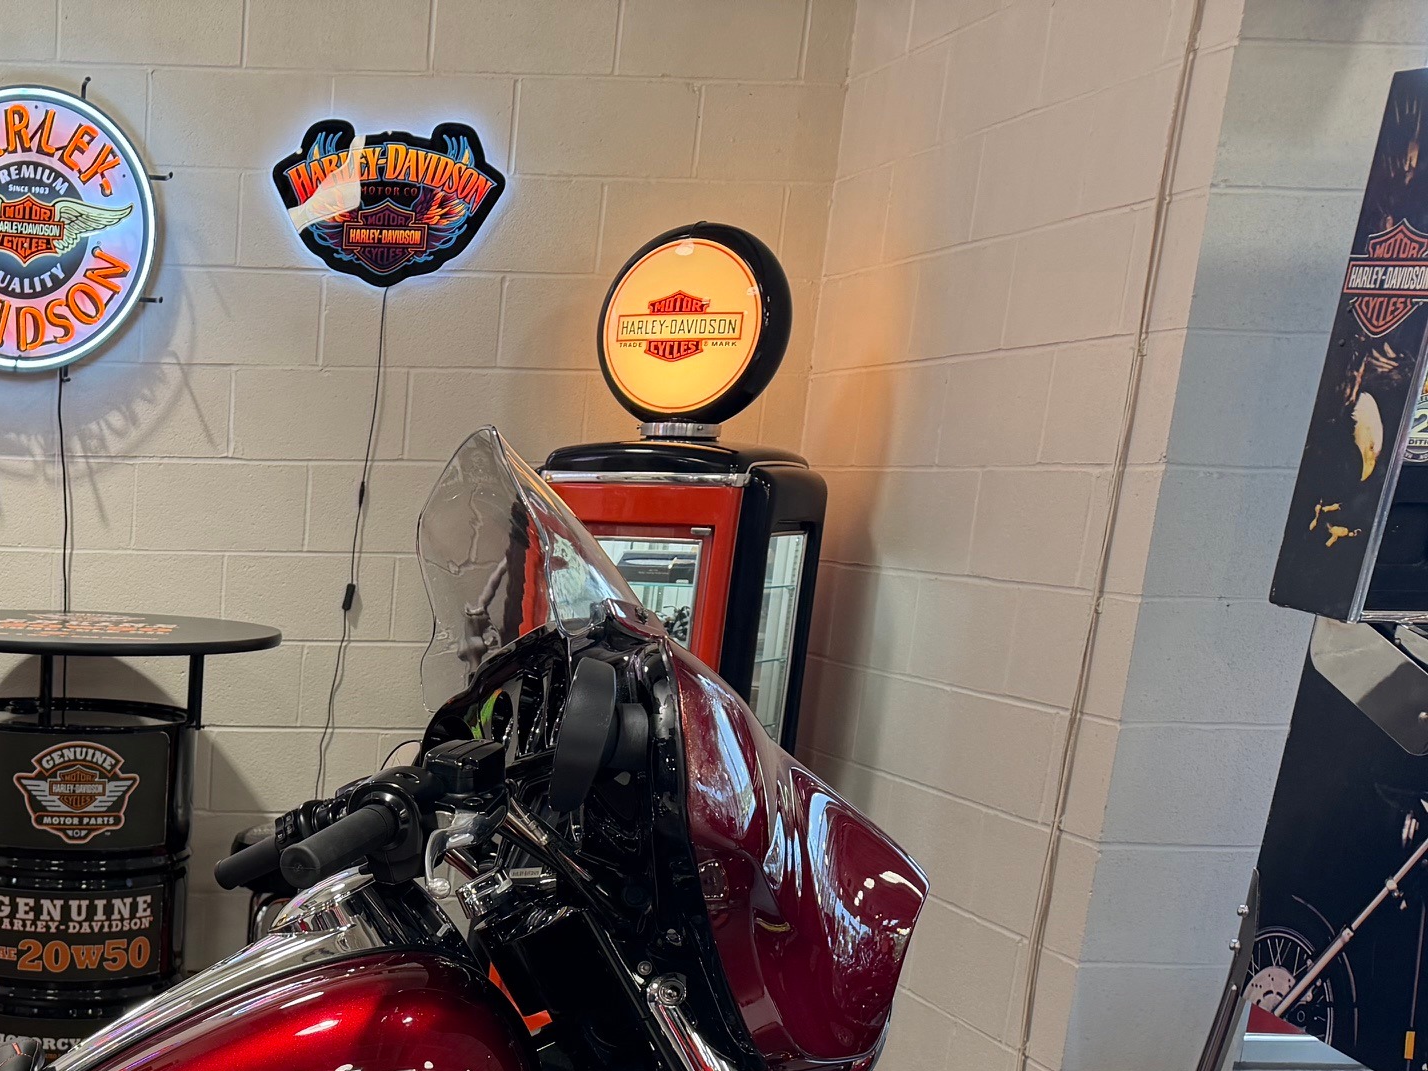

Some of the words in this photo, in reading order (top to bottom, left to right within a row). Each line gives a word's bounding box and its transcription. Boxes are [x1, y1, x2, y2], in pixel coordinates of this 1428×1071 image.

[287, 143, 492, 212] HARLEY-DAVIDSON
[32, 186, 50, 195] 1903
[361, 185, 400, 196] MOTOR
[403, 186, 419, 196] CO
[5, 202, 51, 221] MOTOR
[368, 214, 407, 226] MOTOR
[349, 228, 422, 245] HARLEY-DAVIDSON
[3, 236, 48, 259] CYCLES
[1374, 233, 1420, 258] MOTOR
[365, 248, 404, 263] CYCLES
[654, 294, 703, 312] MOTOR
[1362, 297, 1405, 326] CYCLES
[621, 318, 738, 336] HARLEY-DAVIDSON
[650, 341, 698, 359] CYCLES
[41, 746, 116, 771] GENUINE
[64, 771, 93, 782] MOTOR
[52, 783, 103, 794] HARLEY-DAVIDSON
[64, 796, 92, 808] CYCLES
[43, 816, 80, 825] MOTOR
[82, 816, 115, 825] PARTS
